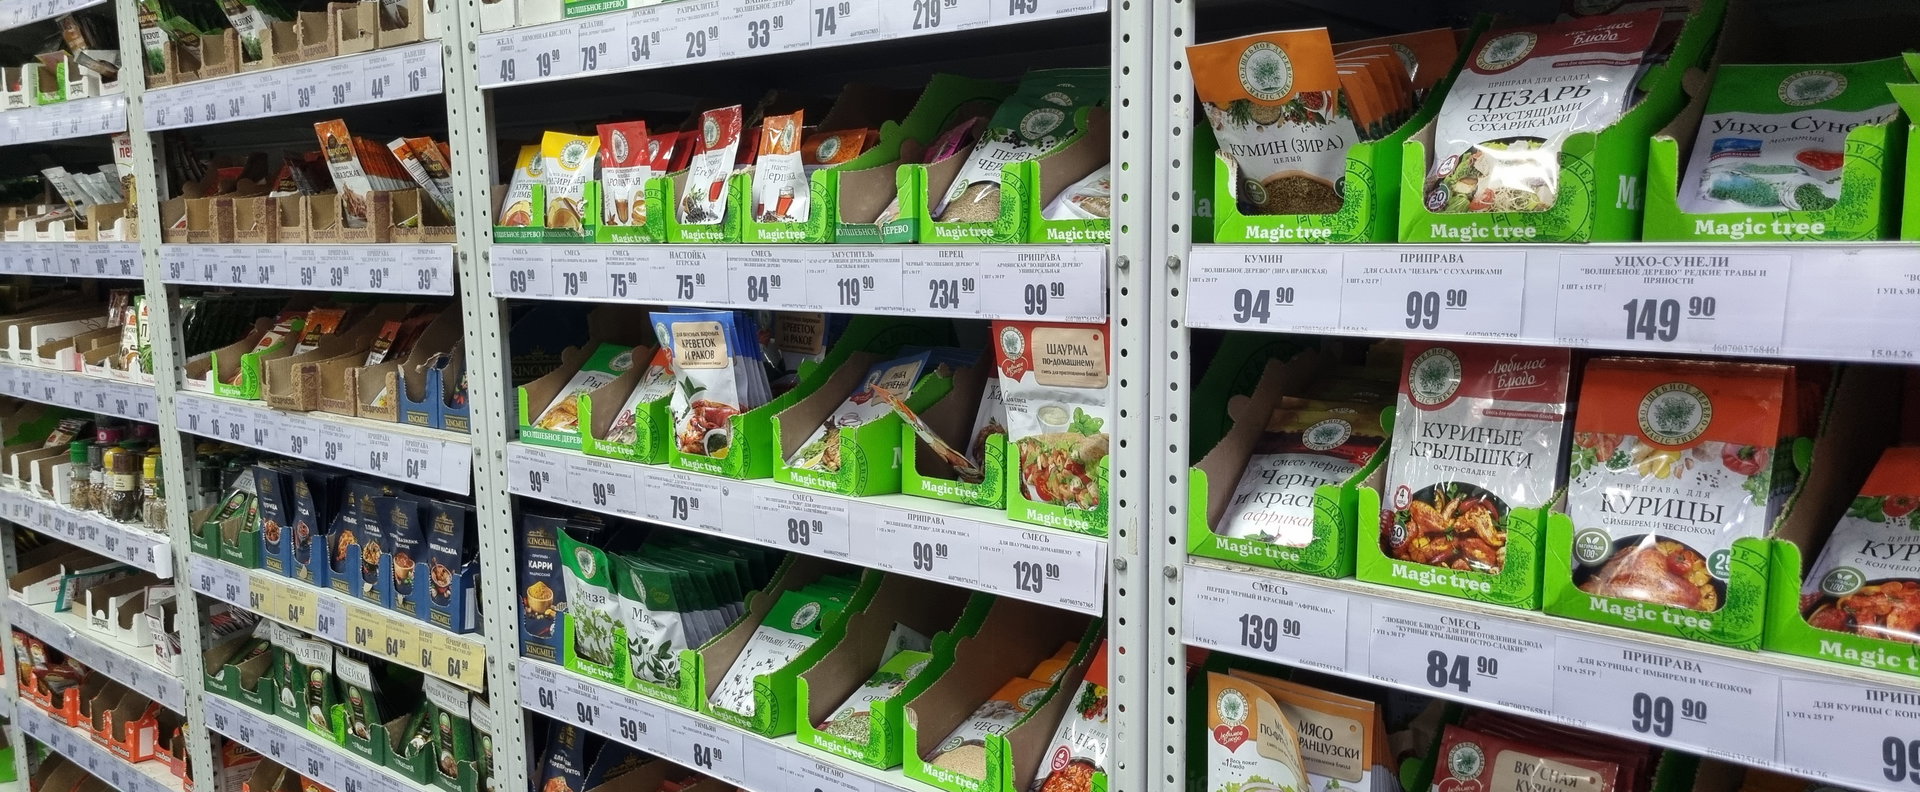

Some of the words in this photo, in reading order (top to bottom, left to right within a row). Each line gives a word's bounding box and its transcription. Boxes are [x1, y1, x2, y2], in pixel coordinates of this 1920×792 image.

[567, 3, 601, 14] ВОЛШЕБНОЕ
[603, 0, 624, 9] ДЕРЕВО
[913, 0, 940, 30] 219
[686, 30, 706, 58] 29
[708, 26, 718, 39] 90
[748, 20, 770, 48] 33
[773, 16, 783, 28] 90
[631, 35, 650, 62] 34
[652, 31, 660, 43] 90
[372, 78, 383, 99] 44
[408, 70, 419, 92] 16
[1488, 78, 1532, 88] ПРИПРАВА
[1535, 76, 1551, 84] ДЛЯ
[1555, 74, 1591, 83] САЛАТА
[332, 84, 344, 104] 39
[1471, 85, 1591, 114] ЦЕЗАРЬ
[1467, 114, 1477, 122] С
[1480, 102, 1582, 122] ХРУСТЯЩИМИ
[1470, 115, 1570, 132] СУХАРИКАМИ
[1230, 140, 1287, 157] КУМИН
[1291, 135, 1343, 152] (ЗИРА)
[1273, 156, 1301, 164] ЦЕЛЫЙ
[936, 227, 966, 238] Magic
[969, 227, 993, 237] tree
[1246, 225, 1294, 242] Magic
[1297, 227, 1331, 238] tree
[1431, 223, 1489, 242] Magic
[1492, 224, 1536, 238] tree
[1695, 218, 1766, 239] Magic
[1771, 220, 1825, 234] tree
[1244, 255, 1283, 264] КУМИН
[1400, 254, 1464, 263] ПРИПРАВА
[1615, 256, 1729, 267] УЦХО-СУНЕЛИ
[418, 270, 430, 290] 39
[510, 270, 526, 293] 69
[527, 269, 534, 279] 90
[1685, 269, 1721, 277] РЕДКИЕ
[748, 276, 769, 302] 84
[771, 275, 781, 286] 90
[838, 278, 860, 306] 119
[863, 277, 874, 289] 90
[930, 280, 959, 309] 234
[962, 278, 974, 291] 90
[1024, 284, 1047, 315] 99
[1051, 282, 1064, 296] 90
[1233, 289, 1270, 324] 94
[1276, 287, 1294, 303] 90
[1405, 291, 1440, 330] 99
[1446, 289, 1467, 307] 90
[1623, 299, 1680, 342] 149
[1689, 297, 1715, 316] 90
[682, 338, 716, 349] КРЕВЕТОК
[1047, 344, 1088, 356] ШАУРМА
[1871, 349, 1912, 358] 15.04.26
[1042, 357, 1094, 369] по-домашнему
[1488, 353, 1545, 375] Любимое
[1498, 371, 1536, 388] Блюдо
[408, 412, 429, 425] KINGMILL
[1422, 422, 1523, 446] КУРИНЫЕ
[370, 451, 381, 471] 64
[1273, 457, 1306, 467] смесь
[1310, 461, 1355, 474] перцев
[1409, 441, 1533, 469] КРЫЛЫШКИ
[407, 458, 419, 479] 64
[1433, 464, 1496, 477] ОСТРО-СЛАДКИЕ
[793, 493, 813, 502] СМЕСЬ
[1617, 483, 1679, 495] ПРИПРАВА
[1686, 489, 1711, 498] ДЛЯ
[671, 496, 688, 520] 79
[690, 497, 699, 508] 90
[1600, 493, 1725, 525] КУРИЦЫ
[907, 513, 945, 525] ПРИПРАВА
[1027, 509, 1062, 527] Magic
[1064, 515, 1088, 530] tree
[1611, 518, 1651, 527] ИМБИРЕМ
[1663, 522, 1716, 536] ЧЕСНОКОМ
[788, 518, 810, 545] 89
[812, 520, 822, 532] 90
[1022, 532, 1049, 543] СМЕСЬ
[529, 560, 553, 570] КАРРИ
[913, 542, 933, 571] 99
[936, 543, 948, 557] 90
[1013, 561, 1042, 593] 129
[1046, 564, 1059, 579] 90
[1392, 563, 1446, 586] Magic
[1450, 574, 1490, 592] tree
[1207, 586, 1230, 595] ПЕРЦЕВ
[1231, 590, 1256, 600] ЧЕРНЫЙ
[1263, 596, 1293, 607] КРАСНЫЙ
[1252, 582, 1288, 596] СМЕСЬ
[1440, 616, 1480, 630] СМЕСЬ
[1590, 596, 1656, 622] Magic
[1661, 609, 1712, 631] tree
[1239, 613, 1277, 652] 139
[1283, 619, 1300, 636] 90
[1430, 630, 1468, 643] КРЫЛЫШКИ
[1460, 628, 1516, 645] ПРИГОТОВЛЕНИЯ
[1518, 639, 1543, 649] БЛЮДА
[448, 657, 460, 679] 64
[1427, 650, 1471, 692] 84
[1477, 656, 1498, 675] 90
[1623, 650, 1702, 673] ПРИПРАВА
[1577, 656, 1594, 665] ДЛЯ
[1596, 661, 1633, 674] КУРИЦЫ
[1643, 668, 1687, 683] ИМБИРЕМ
[1690, 676, 1696, 684] И
[1699, 679, 1752, 695] ЧЕСНОКОМ
[1632, 692, 1673, 737] 99
[1682, 698, 1707, 720] 90
[620, 717, 638, 742] 59
[639, 721, 647, 732] 90
[1298, 720, 1333, 741] МЯСО
[694, 743, 712, 769] 84
[714, 748, 722, 760] 90
[1297, 737, 1360, 760] РАНЦУЗСКИ
[308, 758, 319, 777] 59
[816, 764, 844, 779] ОРЕГАНО
